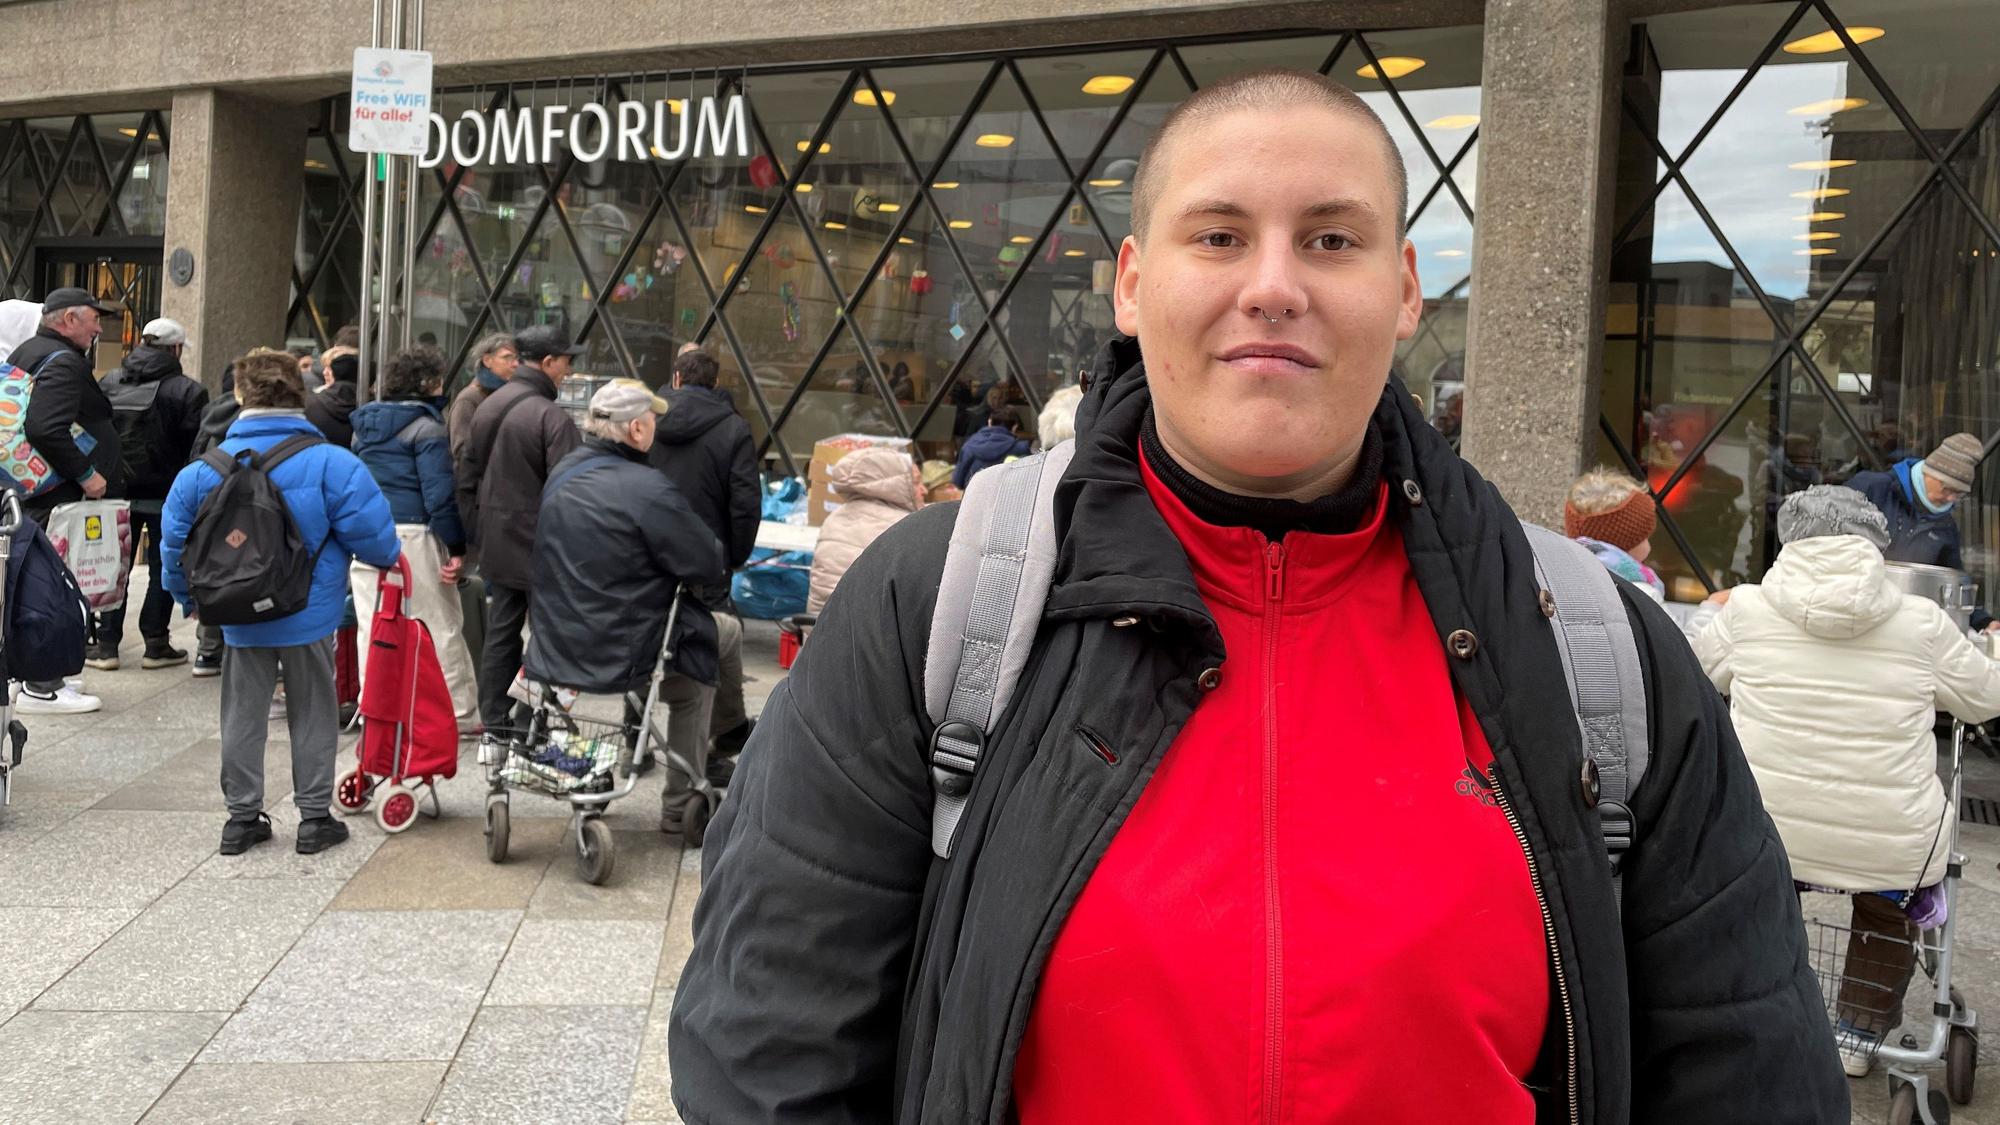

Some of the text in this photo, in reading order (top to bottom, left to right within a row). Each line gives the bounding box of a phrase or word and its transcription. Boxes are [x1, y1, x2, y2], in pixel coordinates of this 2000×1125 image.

[356, 91, 426, 107] Free WiFi
[355, 106, 413, 122] für alle!
[418, 94, 748, 168] DOMFORUM
[76, 567, 96, 577] frisch
